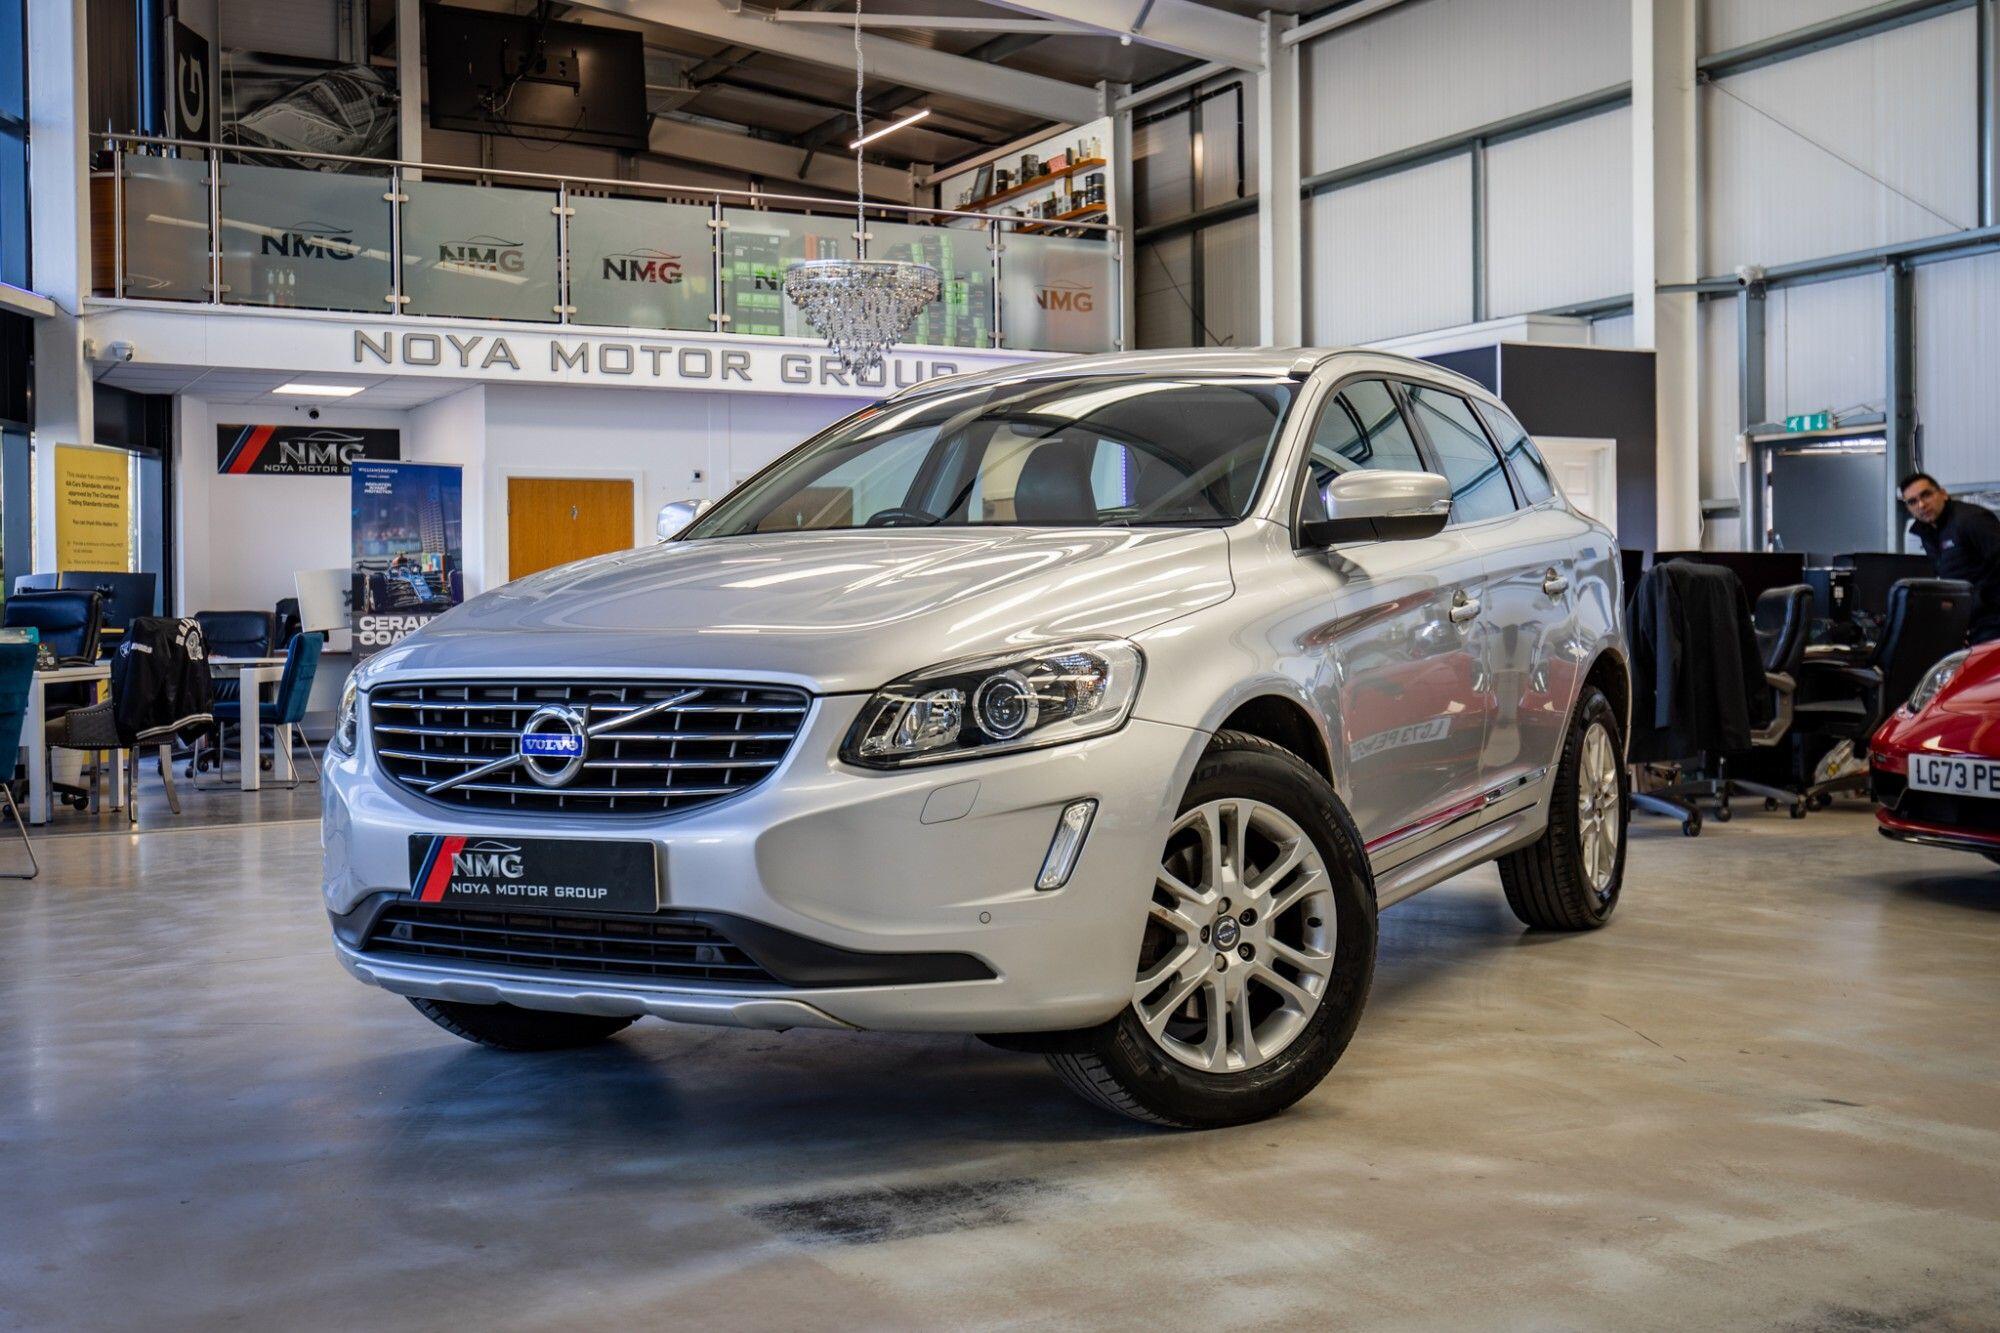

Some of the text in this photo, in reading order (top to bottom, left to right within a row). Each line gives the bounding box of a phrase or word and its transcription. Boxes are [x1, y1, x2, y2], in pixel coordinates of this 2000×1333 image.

[261, 233, 354, 260] NMG
[439, 245, 524, 273] NMG
[602, 258, 682, 284] NMG
[354, 330, 520, 370] NOYA
[551, 340, 752, 381] MOTOR
[278, 441, 365, 465] NMG
[264, 464, 294, 472] NOYA
[298, 465, 338, 473] MOTOR
[359, 631, 411, 645] COA
[524, 739, 579, 751] VOLVO
[1916, 758, 1967, 789] LG73
[451, 852, 524, 878] NMG
[451, 883, 607, 899] NOYA MOTOR GROUP
